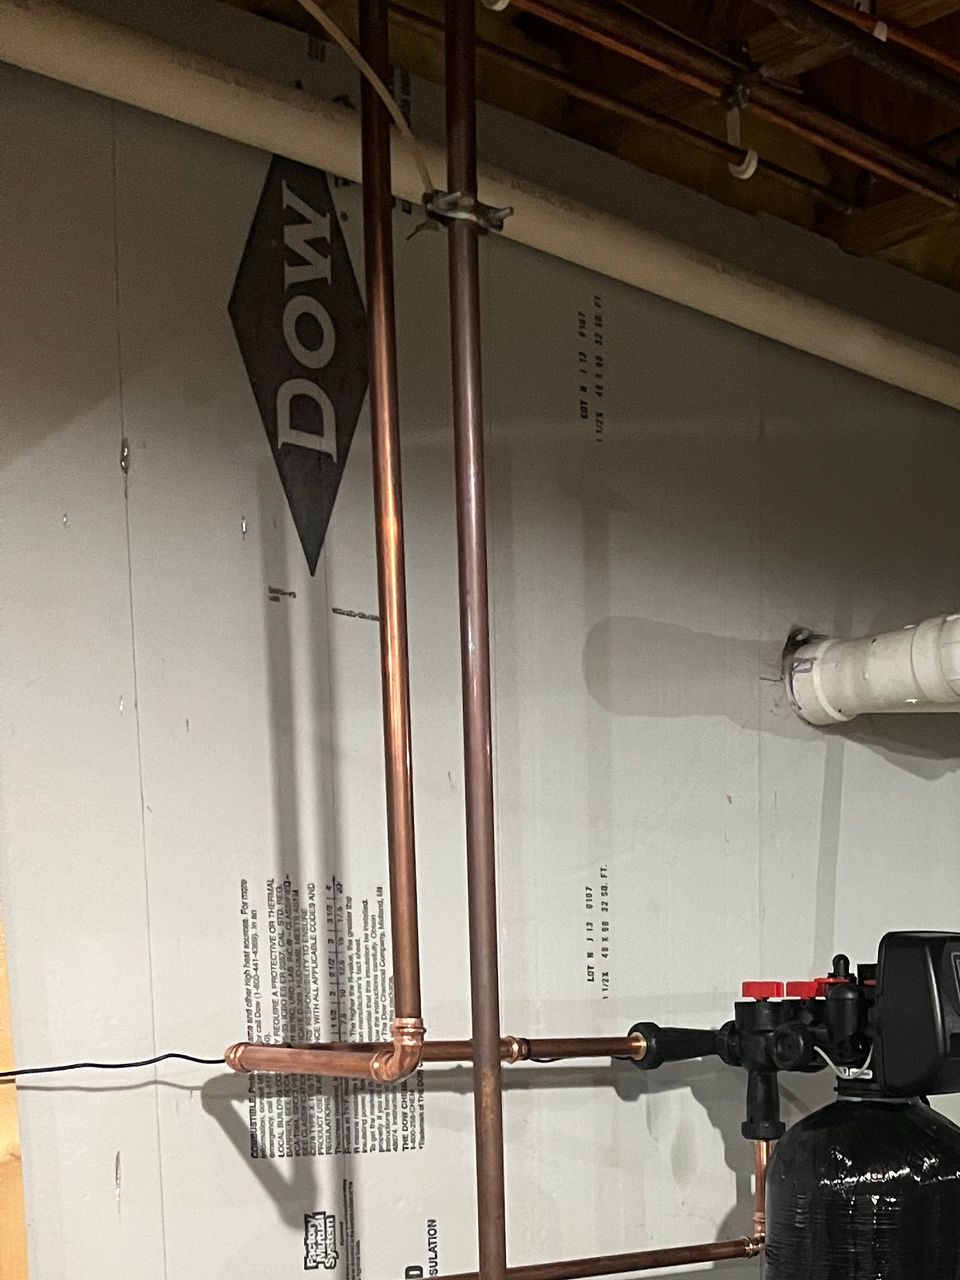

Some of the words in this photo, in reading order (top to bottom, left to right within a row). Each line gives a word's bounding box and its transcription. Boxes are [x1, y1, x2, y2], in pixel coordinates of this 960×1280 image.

[276, 179, 337, 463] DOW
[266, 878, 275, 918] THERMAL
[308, 882, 316, 901] AND
[240, 902, 248, 914] For
[308, 902, 317, 932] CODES
[601, 901, 608, 912] 32
[268, 920, 276, 934] OR
[300, 908, 309, 943] ENSURE
[586, 922, 594, 932] 13
[269, 936, 278, 989] PROTECTIVE
[302, 944, 310, 956] TO
[310, 935, 319, 986] APPLICABLE
[244, 970, 252, 986] high
[586, 966, 594, 982] LOT
[244, 988, 252, 1008] other
[312, 986, 320, 1002] ALL
[272, 998, 280, 1036] REQUIRE
[312, 1004, 320, 1025] WITH
[324, 1096, 332, 1154] REGULATIONS.
[401, 1112, 409, 1132] DOW
[316, 1116, 324, 1156] PRODUCT
[402, 1134, 410, 1152] THE
[306, 1217, 318, 1267] Factory
[316, 1214, 326, 1262] Mutual
[324, 1216, 338, 1268] System
[427, 1220, 438, 1276] SULATION
